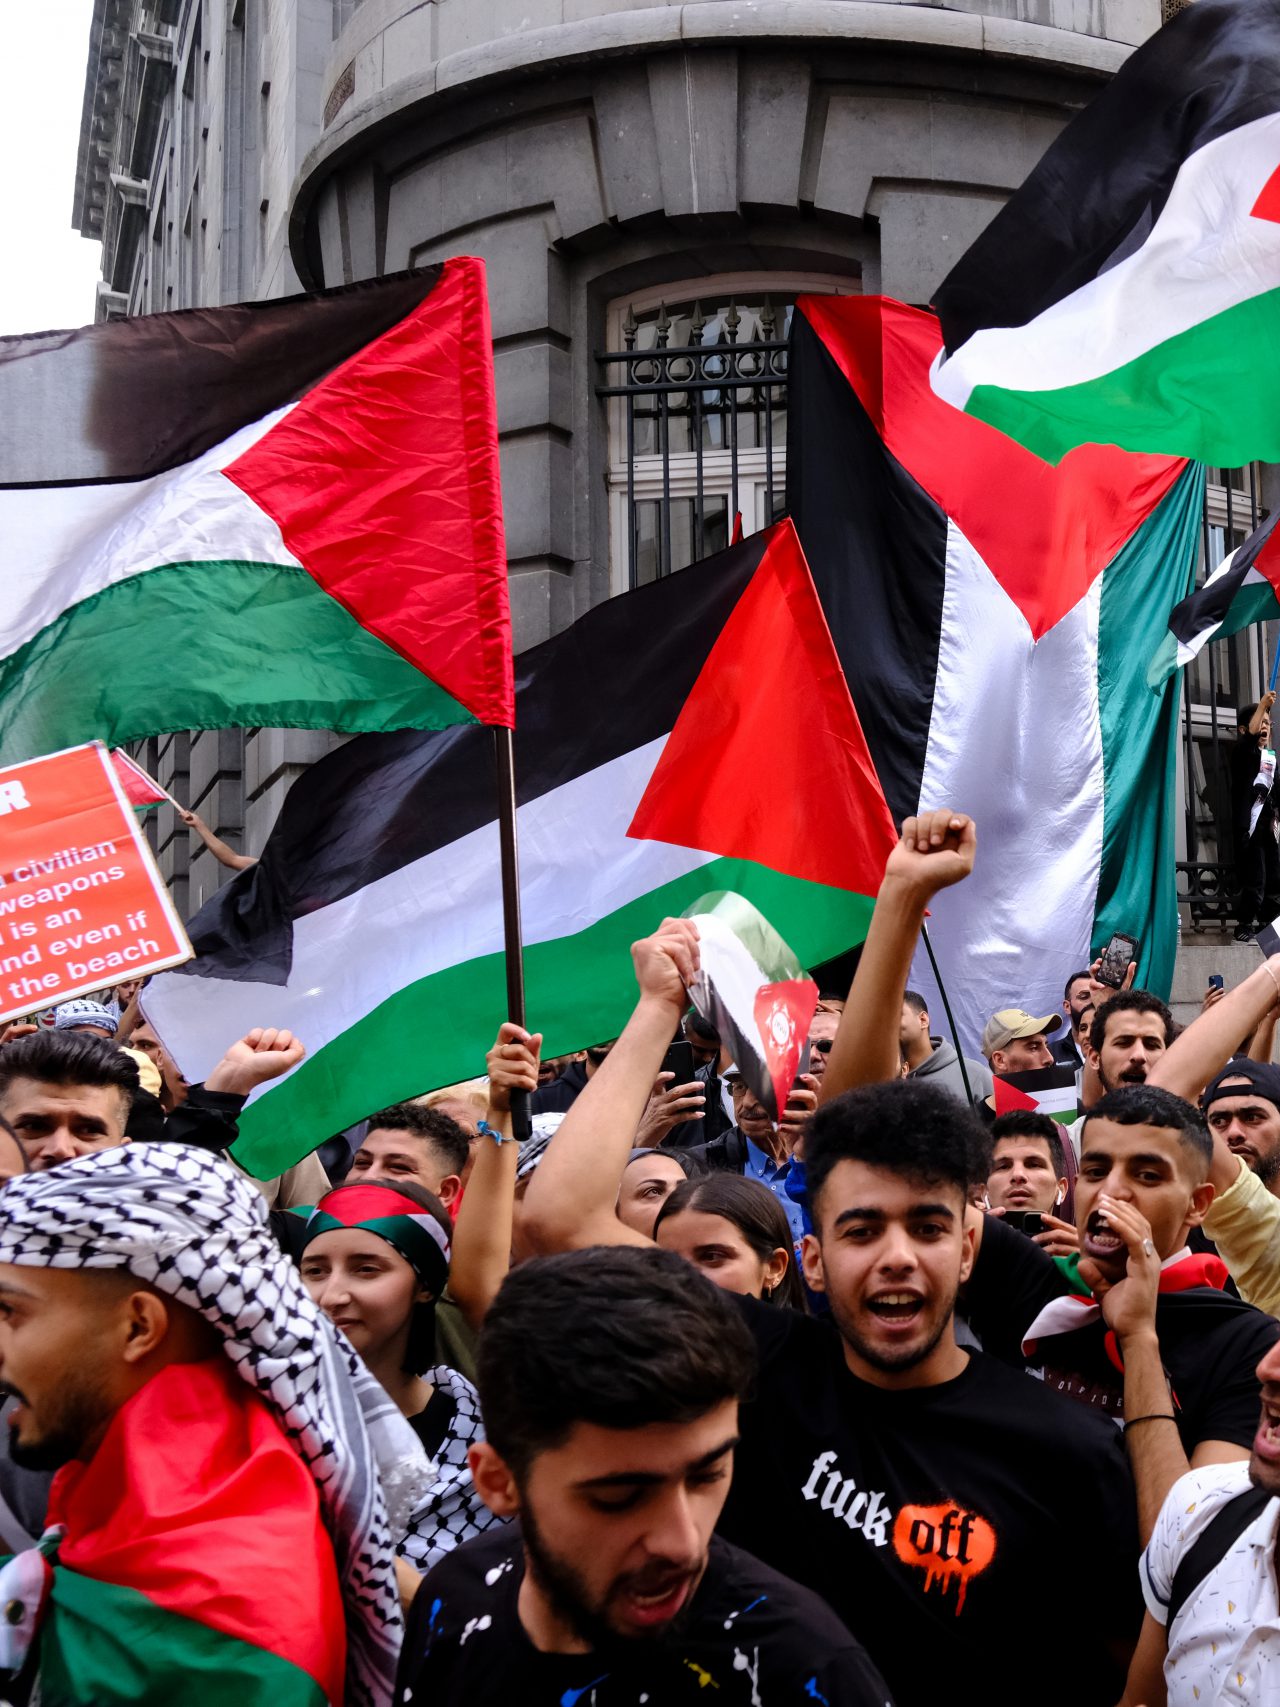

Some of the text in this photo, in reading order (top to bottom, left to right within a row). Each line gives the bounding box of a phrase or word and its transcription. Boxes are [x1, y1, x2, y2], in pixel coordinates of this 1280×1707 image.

[14, 841, 117, 883] civilian
[0, 865, 126, 916] weapons
[9, 922, 38, 940] is
[45, 907, 82, 930] an
[49, 924, 122, 956] even
[129, 910, 148, 932] if
[8, 938, 161, 999] the beach
[801, 1451, 976, 1566] fuck off
